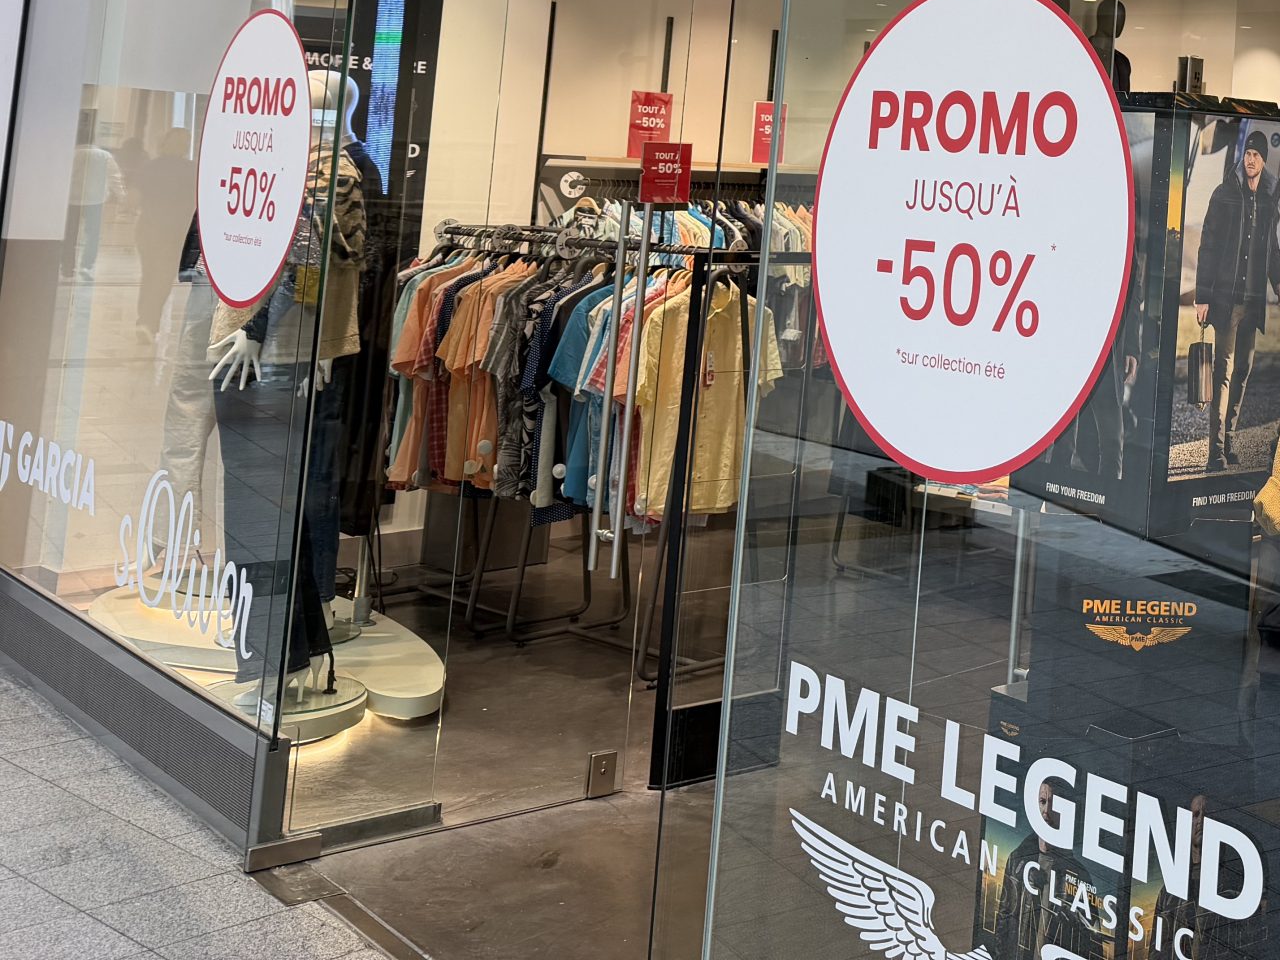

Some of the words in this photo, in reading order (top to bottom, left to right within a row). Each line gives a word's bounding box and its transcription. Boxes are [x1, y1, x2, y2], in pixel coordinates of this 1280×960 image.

[221, 76, 297, 117] PROMO
[637, 105, 659, 114] TOUT
[659, 104, 667, 115] À
[635, 117, 666, 129] -50%
[868, 90, 1078, 157] PROMO
[232, 127, 274, 155] JUSQU'À
[651, 163, 683, 174] -50%
[654, 152, 676, 160] TOUT
[220, 166, 277, 223] -50%
[905, 174, 1021, 221] JUSQU'À
[876, 238, 1040, 338] -50%
[921, 354, 982, 376] collection
[984, 361, 1006, 380] été
[17, 431, 95, 516] GARCIA
[1060, 486, 1077, 498] YOUR
[1076, 489, 1106, 505] FREEDOM
[1192, 496, 1208, 508] FIND
[1208, 494, 1226, 505] YOUR
[1226, 490, 1256, 503] FREEDOM
[114, 469, 254, 659] s.Oliver
[1082, 600, 1122, 614] PME
[1125, 600, 1198, 617] LEGEND
[1094, 615, 1143, 623] AMERICAN
[785, 660, 919, 785] PME
[940, 719, 1264, 920] LEGEND
[820, 772, 999, 876] AMERICAN
[1022, 860, 1195, 960] CLASSIC
